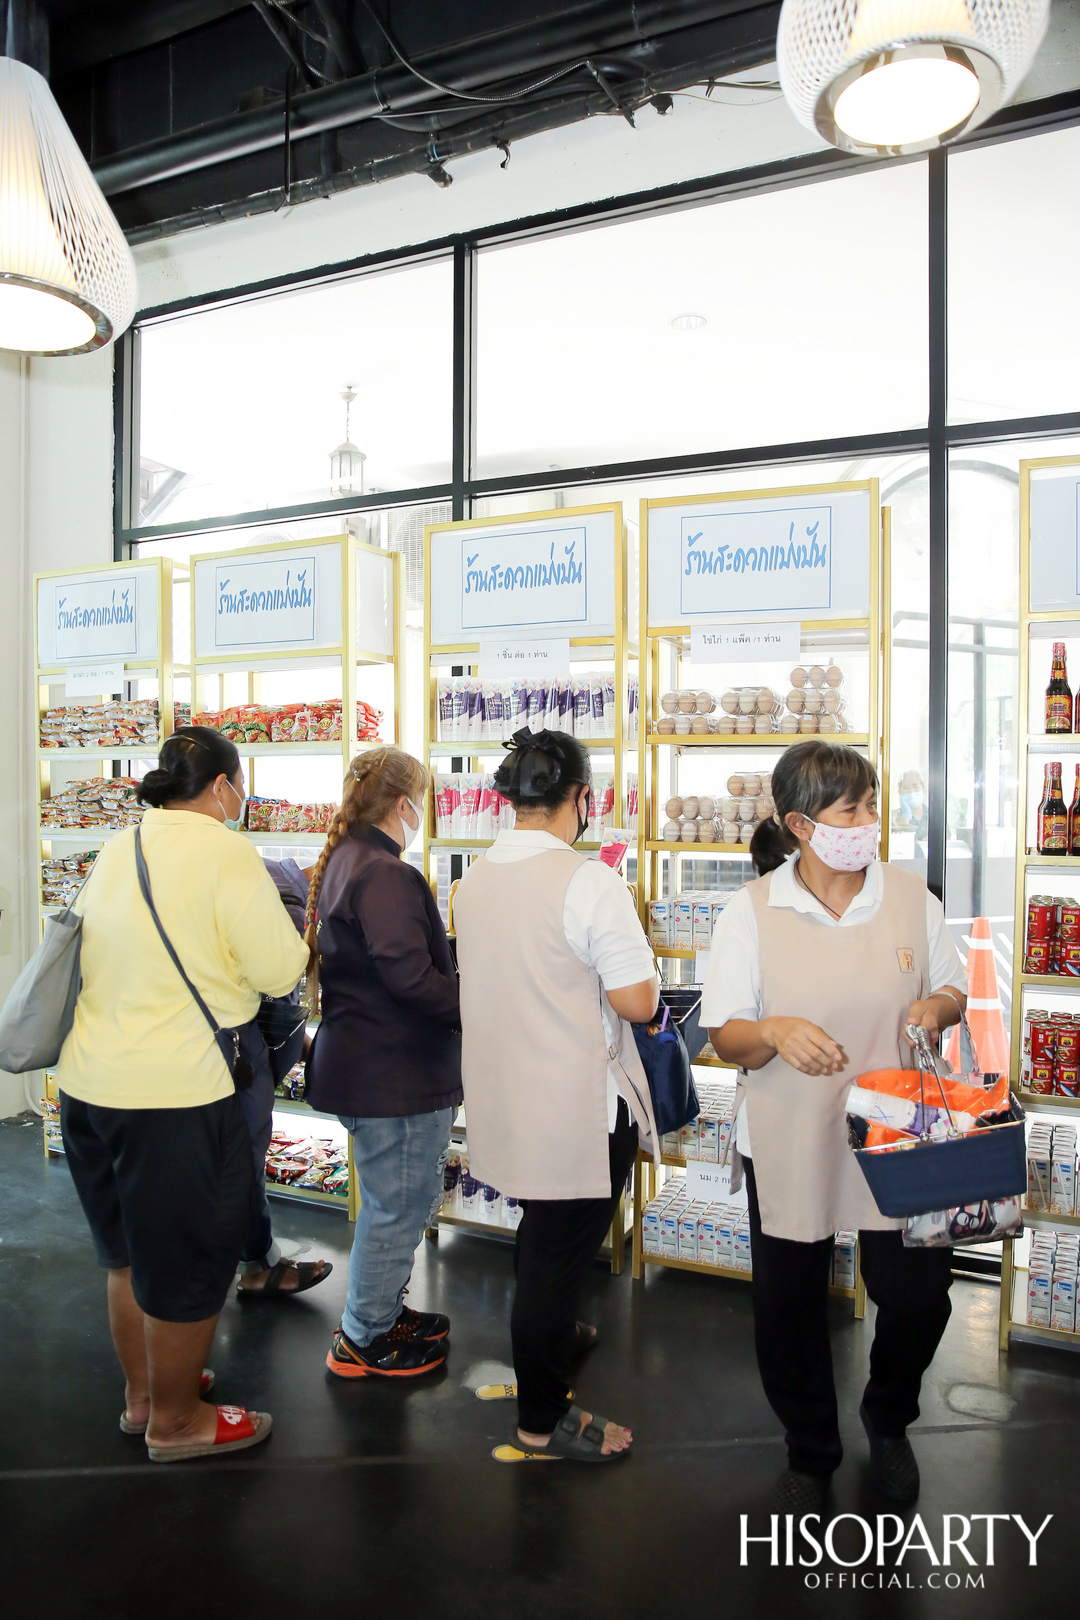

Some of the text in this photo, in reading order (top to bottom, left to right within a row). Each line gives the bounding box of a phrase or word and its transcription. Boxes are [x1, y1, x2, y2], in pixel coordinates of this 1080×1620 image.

[702, 634, 722, 644] ไข่ไก่
[732, 633, 751, 643] แพ็ค
[764, 633, 781, 643] ท่าน
[534, 650, 548, 658] ท่าน
[699, 1173, 712, 1182] นม
